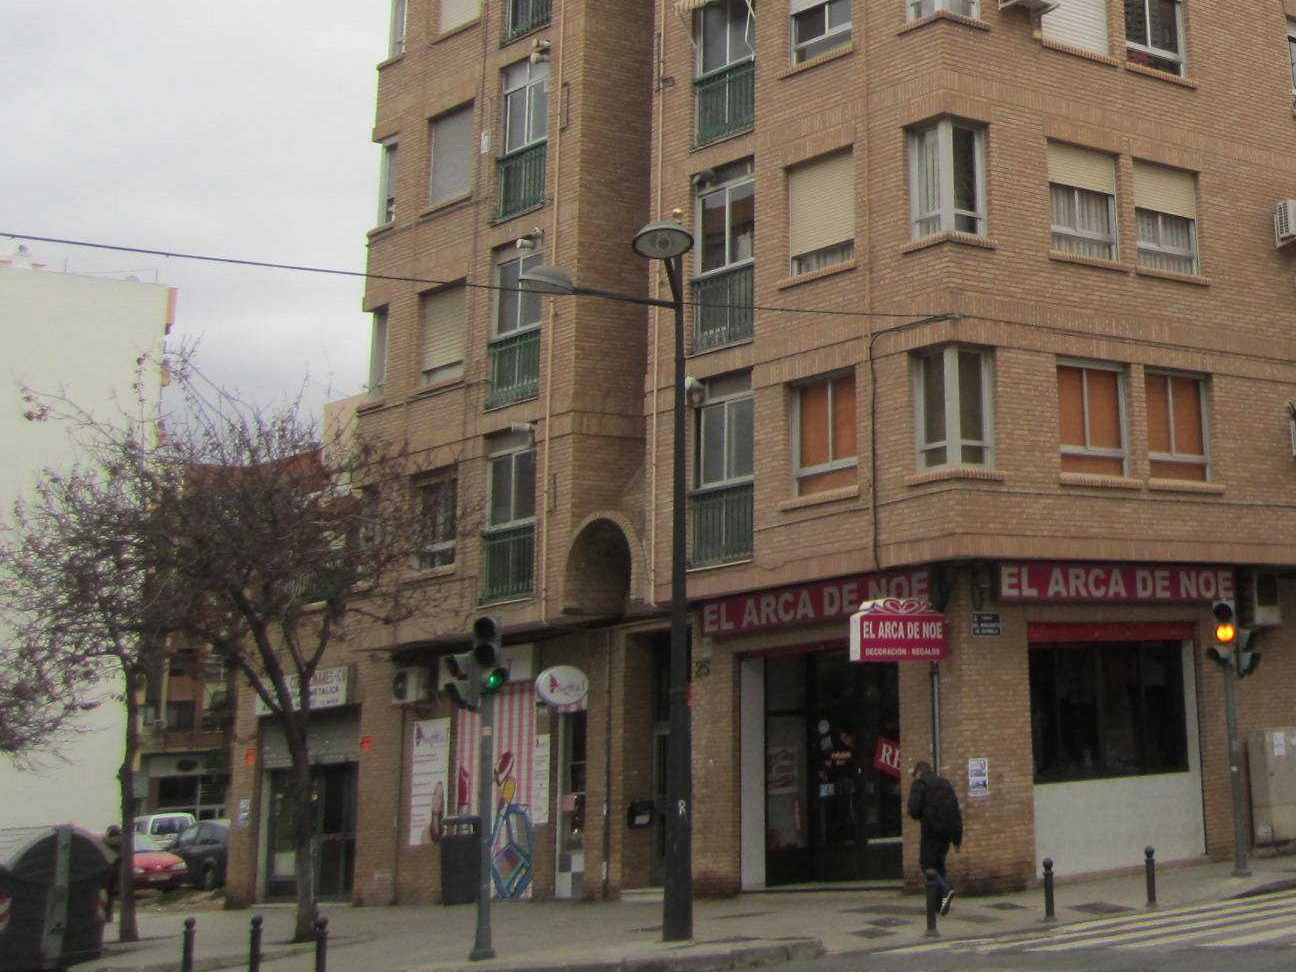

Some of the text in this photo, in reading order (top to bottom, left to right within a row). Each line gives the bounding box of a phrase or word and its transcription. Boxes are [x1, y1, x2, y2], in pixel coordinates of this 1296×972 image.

[1001, 566, 1234, 599] EL ARCA DE NOE
[704, 571, 929, 633] EL ARCA DE NOE
[863, 620, 943, 640] EL ARCA DE NOE
